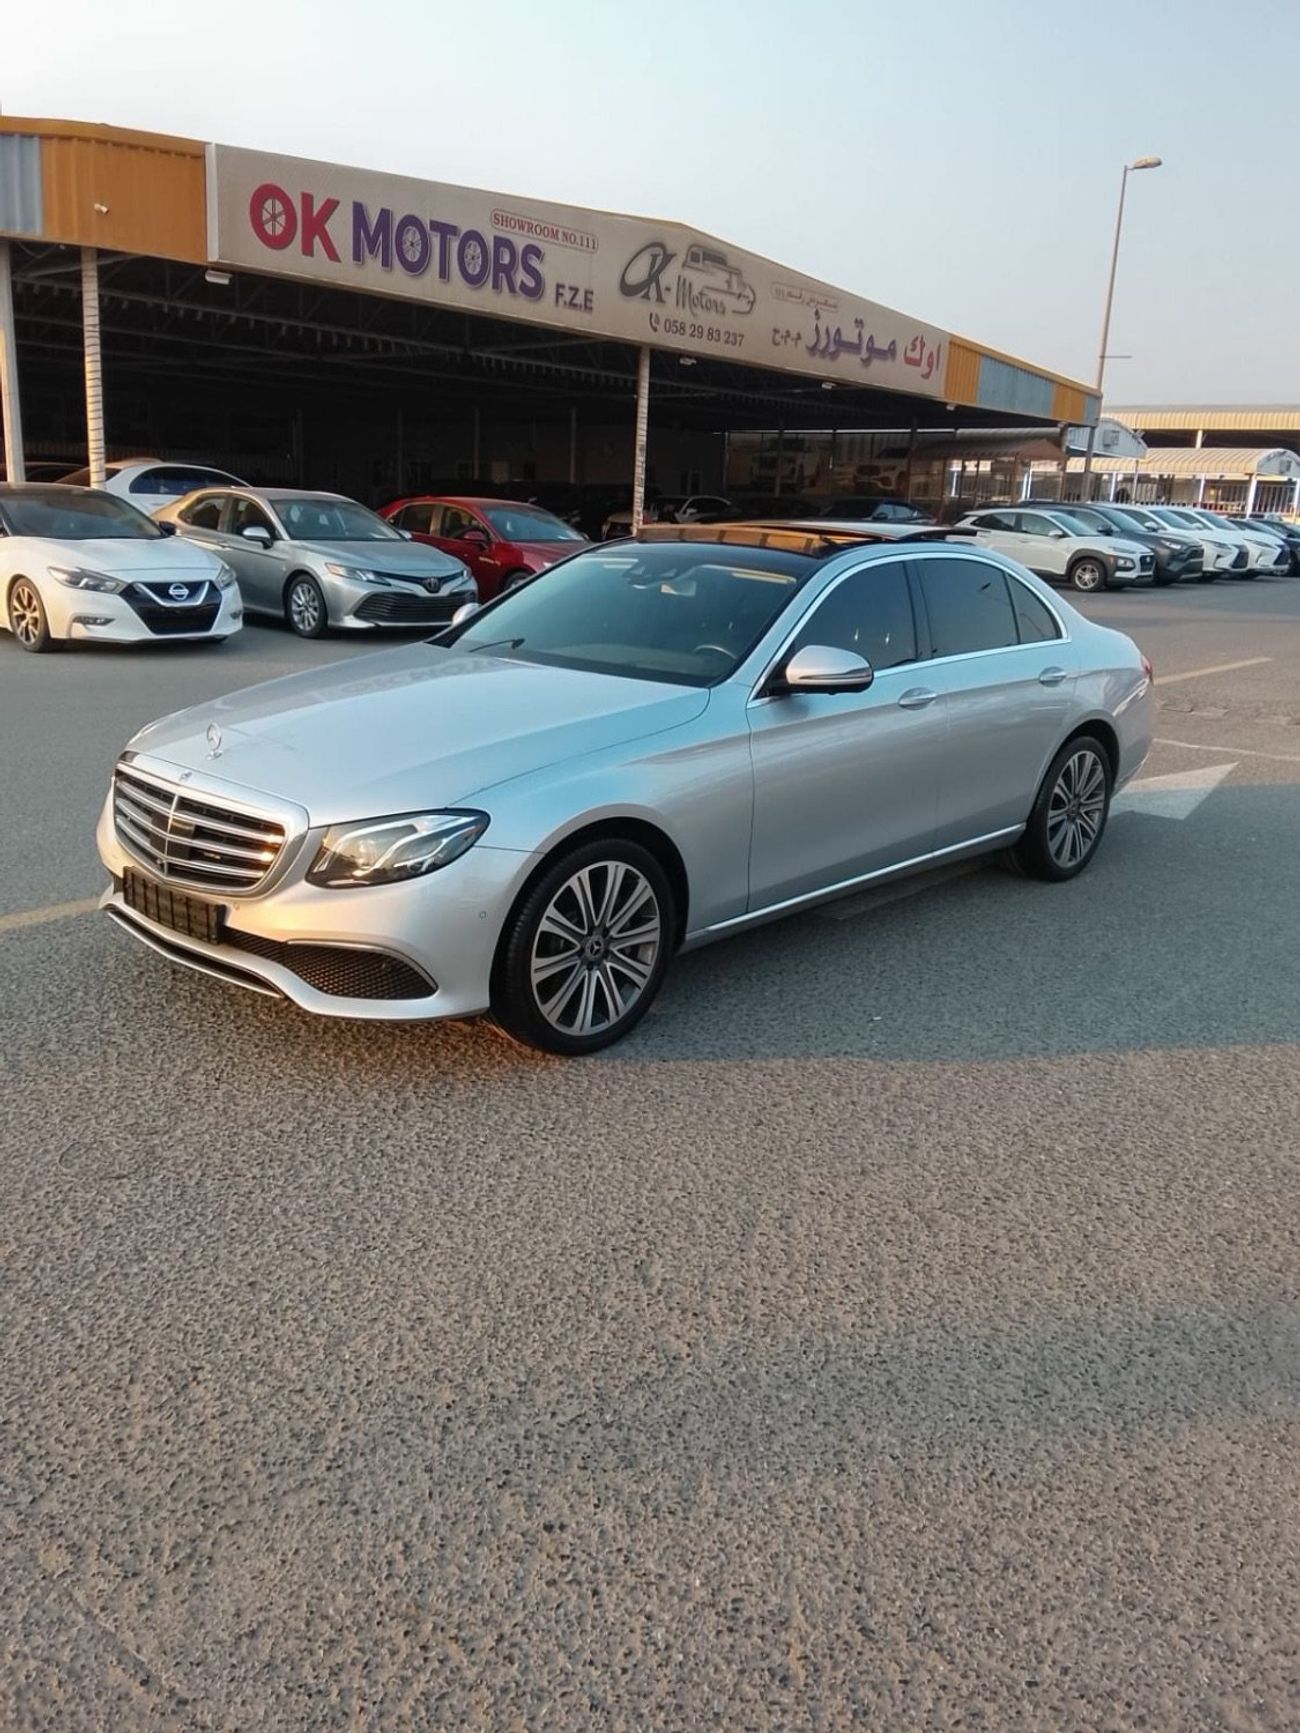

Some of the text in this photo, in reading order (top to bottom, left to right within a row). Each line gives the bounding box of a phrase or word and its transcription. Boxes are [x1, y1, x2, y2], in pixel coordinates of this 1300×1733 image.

[249, 183, 546, 301] OK MOTORS
[492, 211, 560, 241] SHOWROOM
[555, 283, 594, 313] F.Z.E
[663, 317, 746, 349] 058 29 83 237
[804, 307, 898, 368] موتورز
